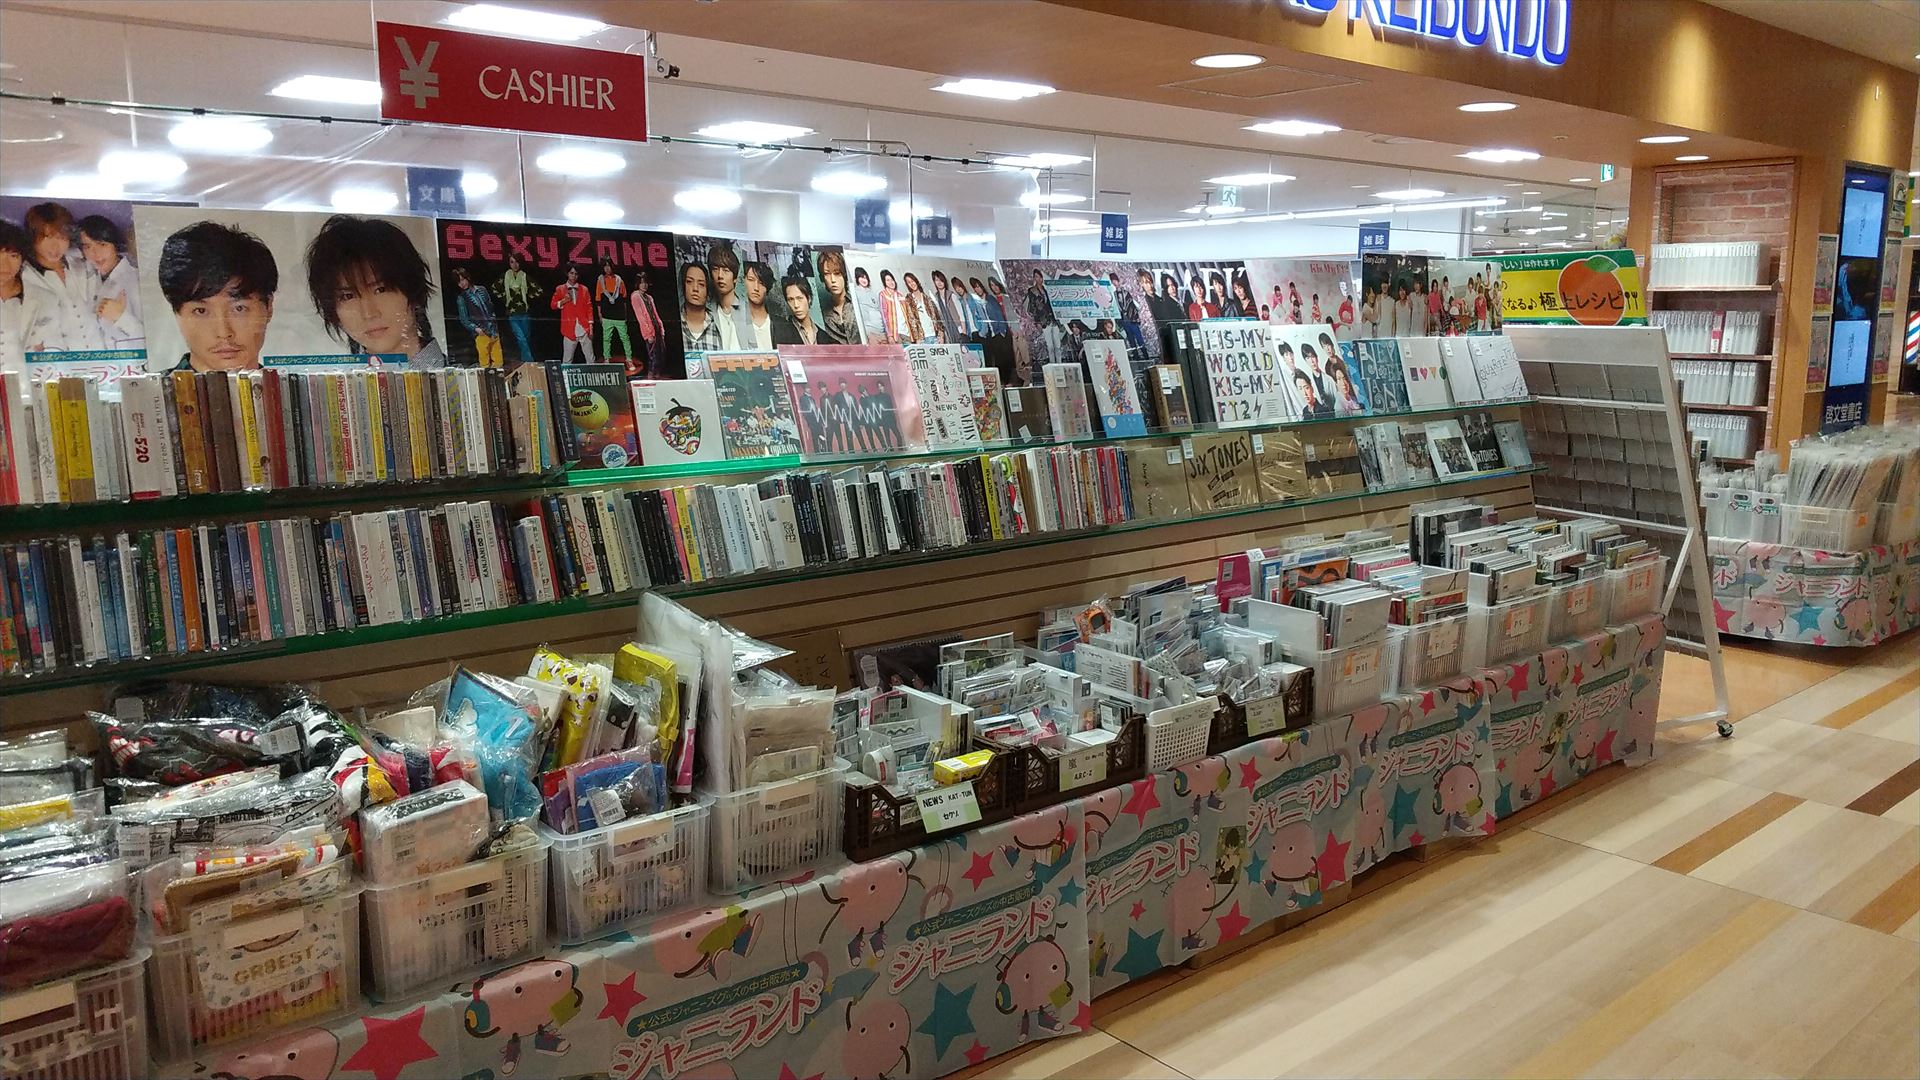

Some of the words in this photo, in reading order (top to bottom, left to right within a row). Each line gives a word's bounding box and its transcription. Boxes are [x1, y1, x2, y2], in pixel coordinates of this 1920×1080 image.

[478, 65, 616, 111] CASHIER
[446, 224, 559, 268] Sexy
[1104, 225, 1125, 240] 雑誌
[1363, 234, 1385, 246] 雑誌
[1540, 291, 1623, 312] 極上レシピ
[1207, 352, 1274, 373] WORLD
[935, 403, 958, 412] NEWS
[1825, 401, 1863, 425] 啓文堂書店
[1380, 734, 1475, 784] ジャニランド
[922, 793, 944, 808] NEWS
[948, 790, 973, 801] KAT-TUN
[1248, 772, 1349, 843] ジャニランド
[892, 899, 1049, 990] ジャニランド
[647, 972, 791, 1026] 公式ジャニーズグッズの中古販売
[611, 981, 818, 1080] ジャニランド
